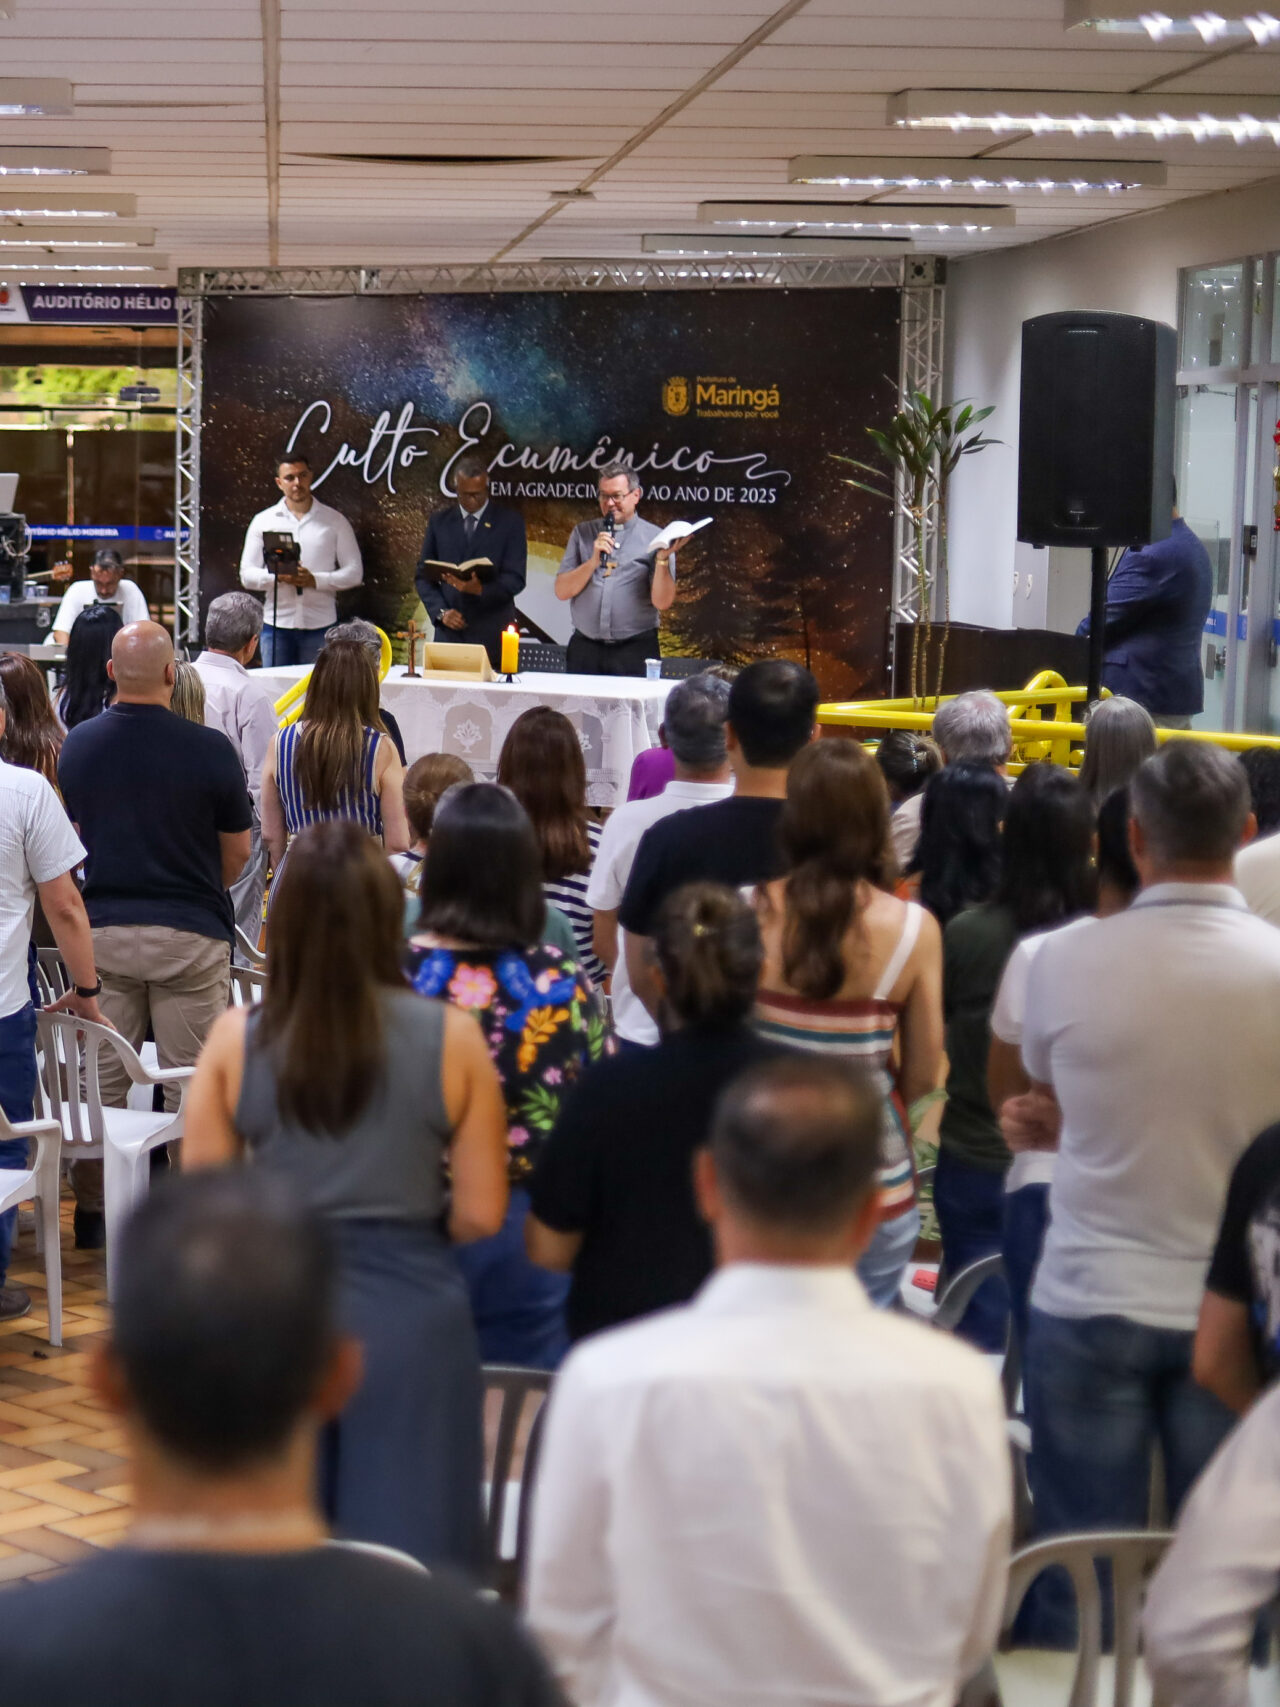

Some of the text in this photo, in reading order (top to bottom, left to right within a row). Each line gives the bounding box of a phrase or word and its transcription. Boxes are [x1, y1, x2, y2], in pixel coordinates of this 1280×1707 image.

[33, 292, 121, 309] AUDITÓRIO
[123, 293, 171, 310] HÉLIO
[696, 384, 780, 411] Maringá
[285, 400, 792, 498] Culto Ecumênico
[490, 481, 777, 503] EM AGRADECIM AO ANO DE 2025
